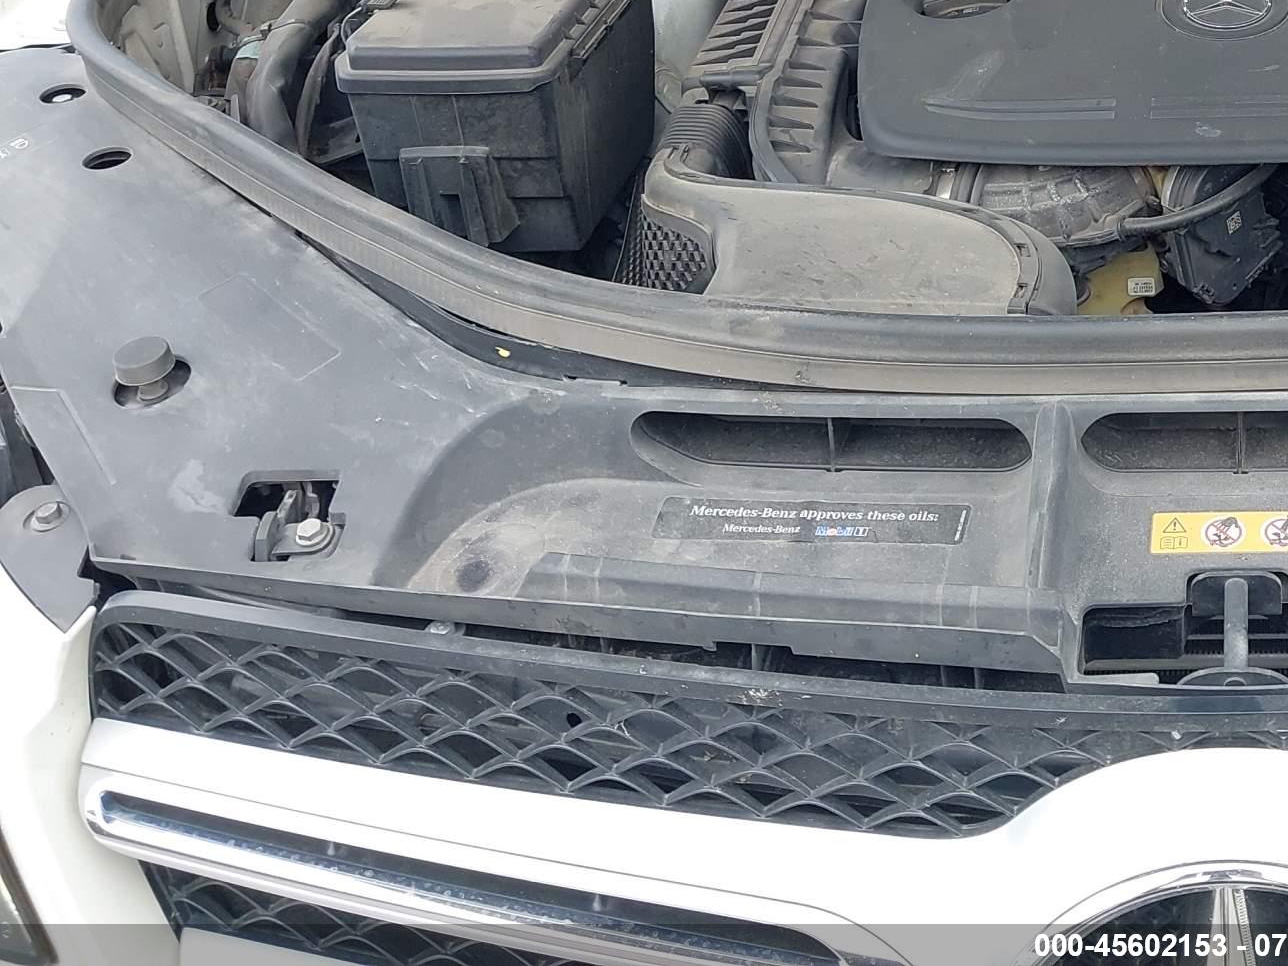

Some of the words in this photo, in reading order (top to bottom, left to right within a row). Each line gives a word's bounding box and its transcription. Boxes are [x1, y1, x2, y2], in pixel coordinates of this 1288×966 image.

[689, 505, 797, 519] Mercedes-Benz
[799, 508, 863, 521] approves
[867, 510, 905, 521] these
[908, 510, 940, 521] oils:
[722, 523, 800, 534] Mercedes-Benz
